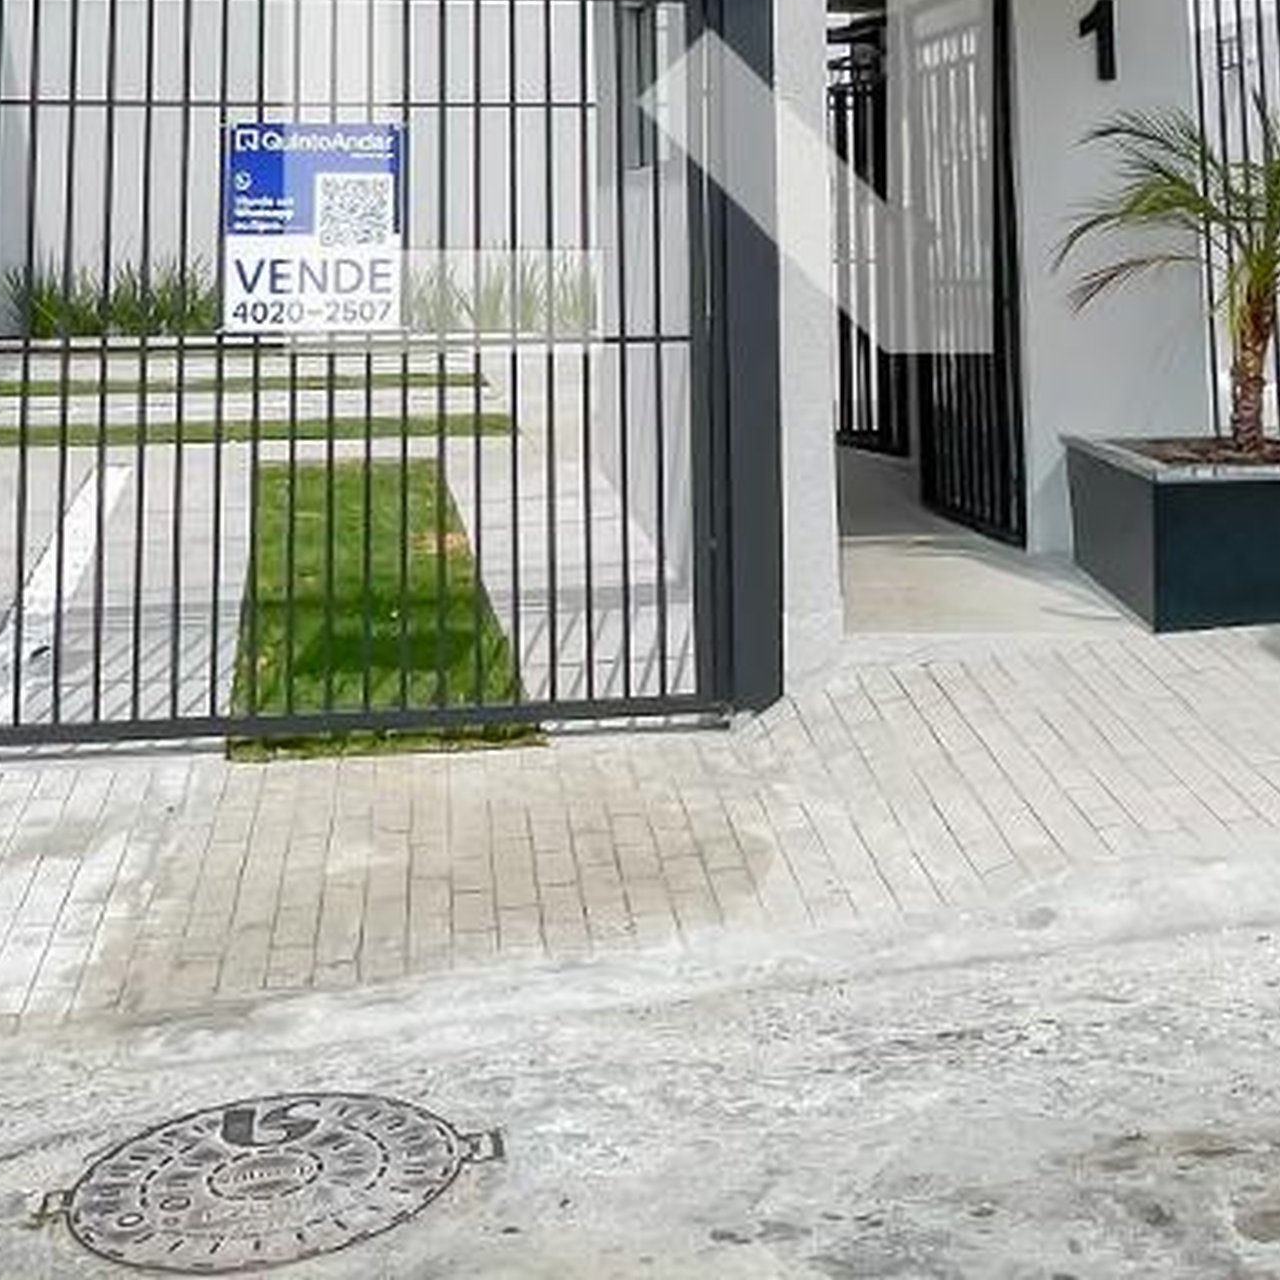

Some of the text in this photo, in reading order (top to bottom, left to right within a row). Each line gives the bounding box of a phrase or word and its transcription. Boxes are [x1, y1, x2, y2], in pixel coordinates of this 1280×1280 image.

[262, 131, 394, 151] QuintoAndar
[234, 259, 393, 294] VENDE
[232, 302, 393, 325] 4020-2507
